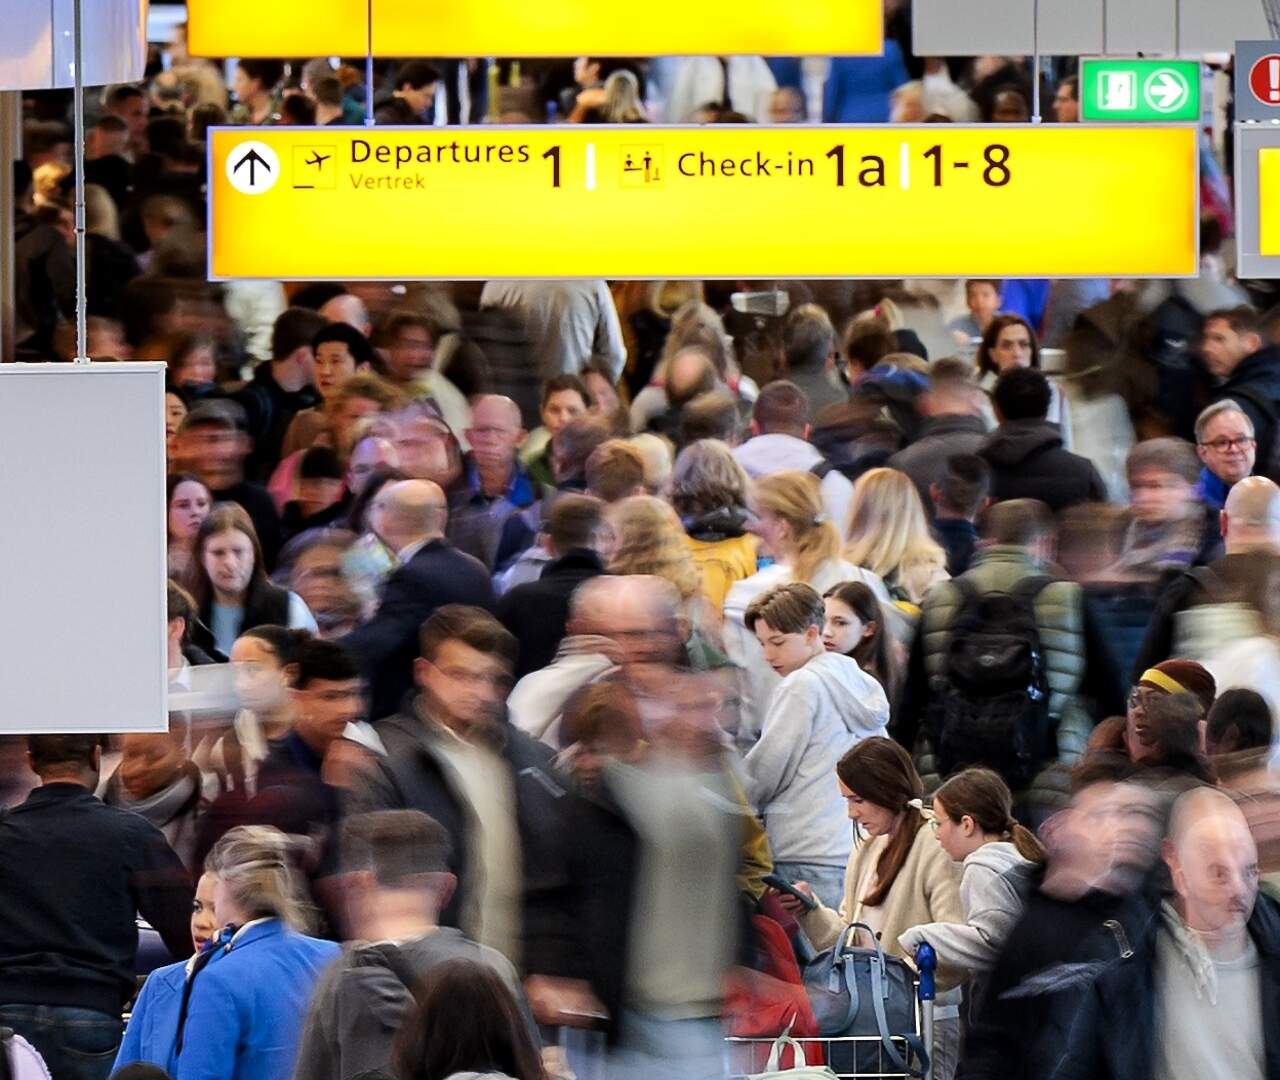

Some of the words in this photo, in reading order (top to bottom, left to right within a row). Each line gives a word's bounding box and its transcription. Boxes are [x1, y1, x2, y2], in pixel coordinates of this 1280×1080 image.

[349, 173, 426, 190] Vertrek
[350, 139, 530, 170] Departures
[541, 145, 562, 188] 1
[677, 150, 815, 177] Check-in
[825, 144, 886, 187] 1a
